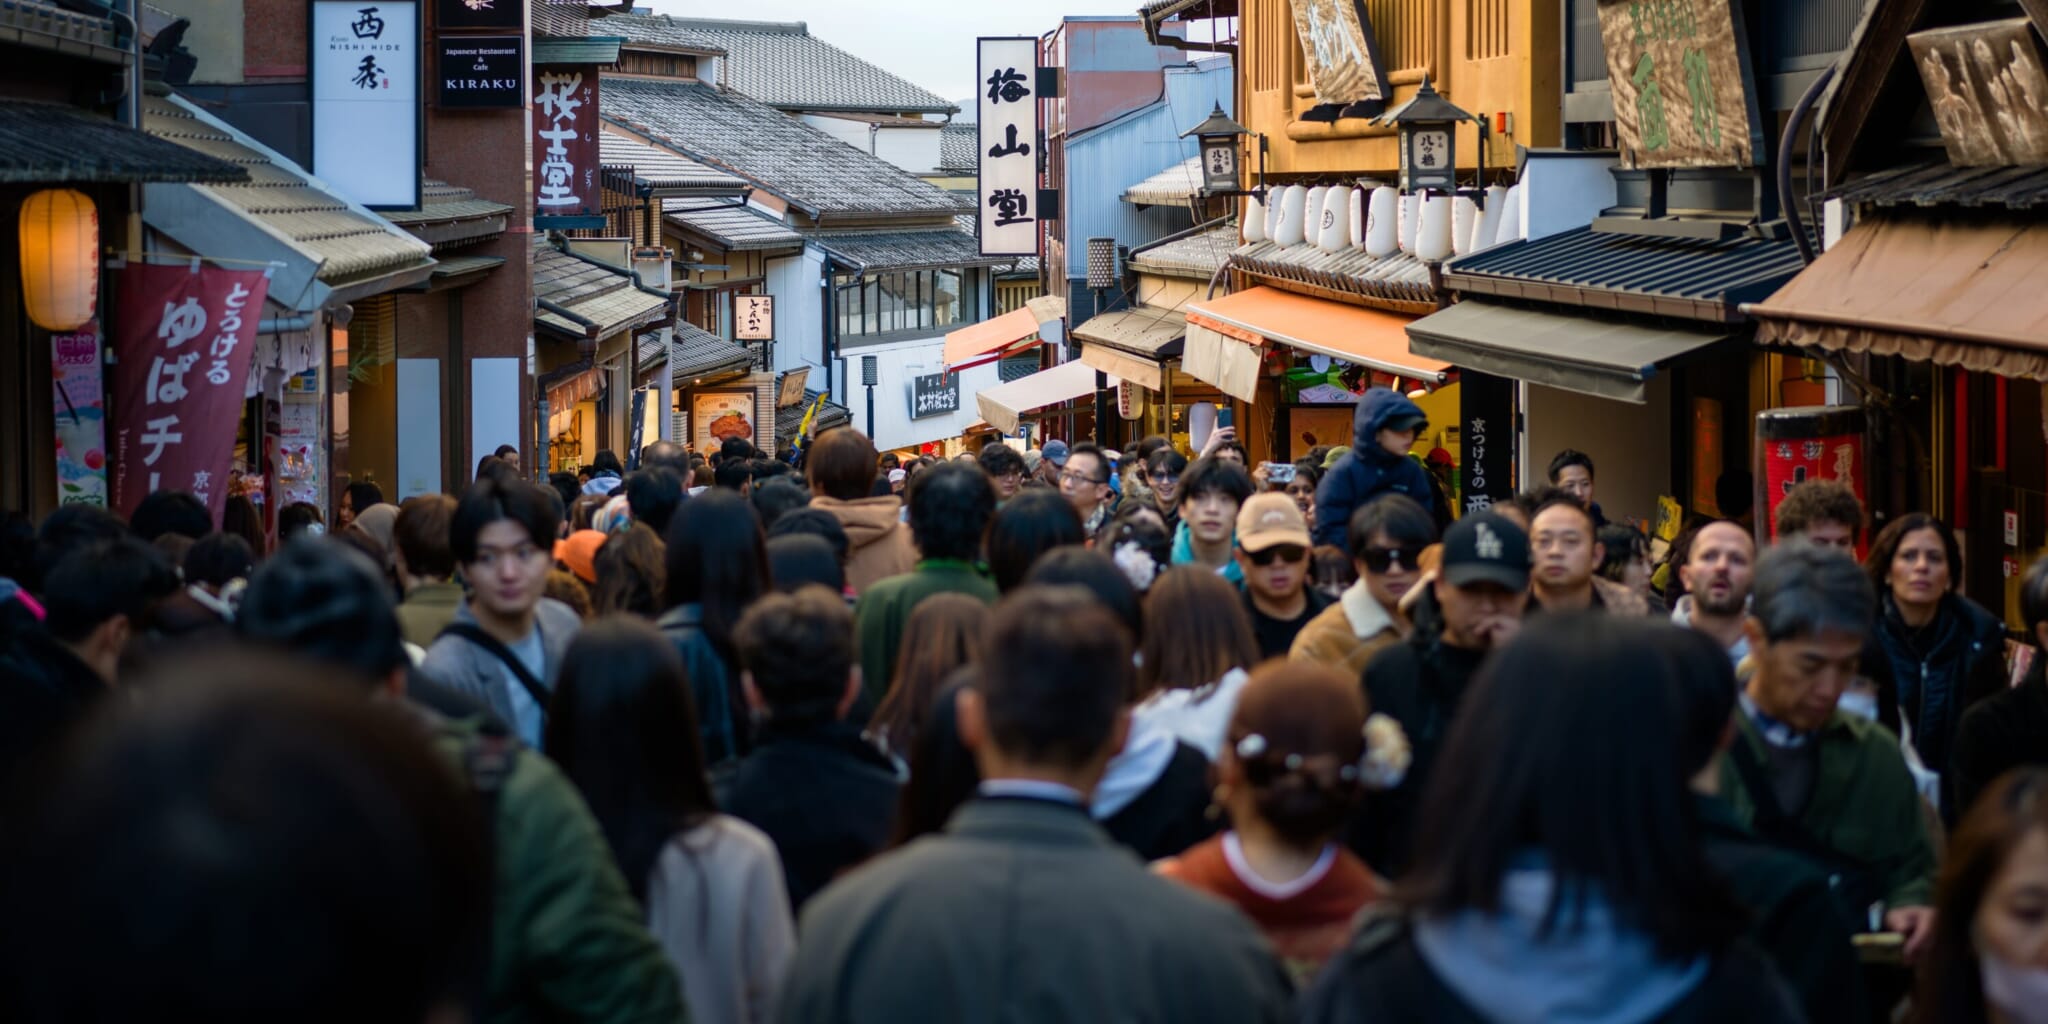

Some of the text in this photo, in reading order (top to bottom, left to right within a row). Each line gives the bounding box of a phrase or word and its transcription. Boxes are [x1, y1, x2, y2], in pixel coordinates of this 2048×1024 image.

[446, 48, 477, 56] Japanese
[446, 79, 516, 89] KIRAKU
[534, 71, 582, 205] 桜士堂
[987, 67, 1034, 227] 梅山堂
[206, 283, 249, 385] とろける
[748, 298, 761, 333] とんかつ
[1471, 417, 1486, 489] 京つけもの
